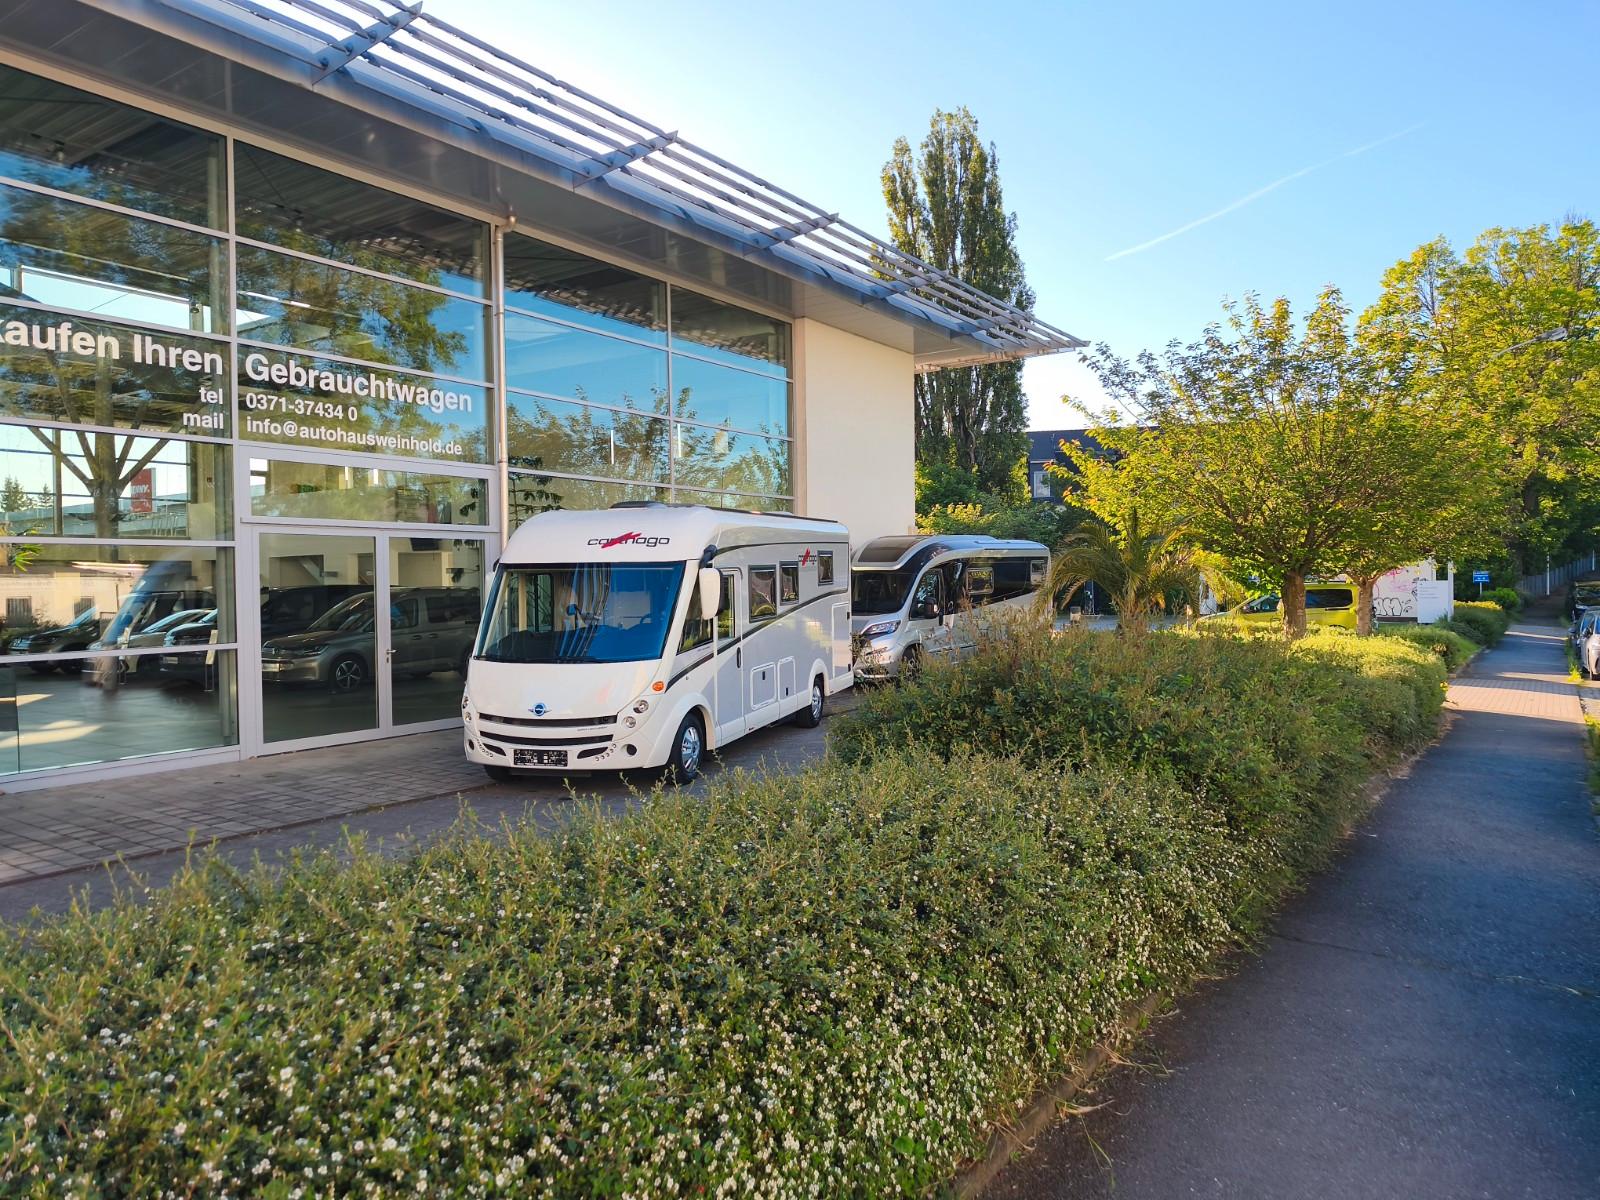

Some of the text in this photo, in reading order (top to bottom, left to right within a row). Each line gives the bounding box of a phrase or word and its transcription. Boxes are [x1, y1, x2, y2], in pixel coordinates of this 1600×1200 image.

[133, 333, 223, 376] Ihren
[245, 353, 473, 414] Gebrauchtwagen
[199, 386, 358, 422] tel 0371-37434 0
[183, 412, 463, 456] mail info@autohausweinhold.de
